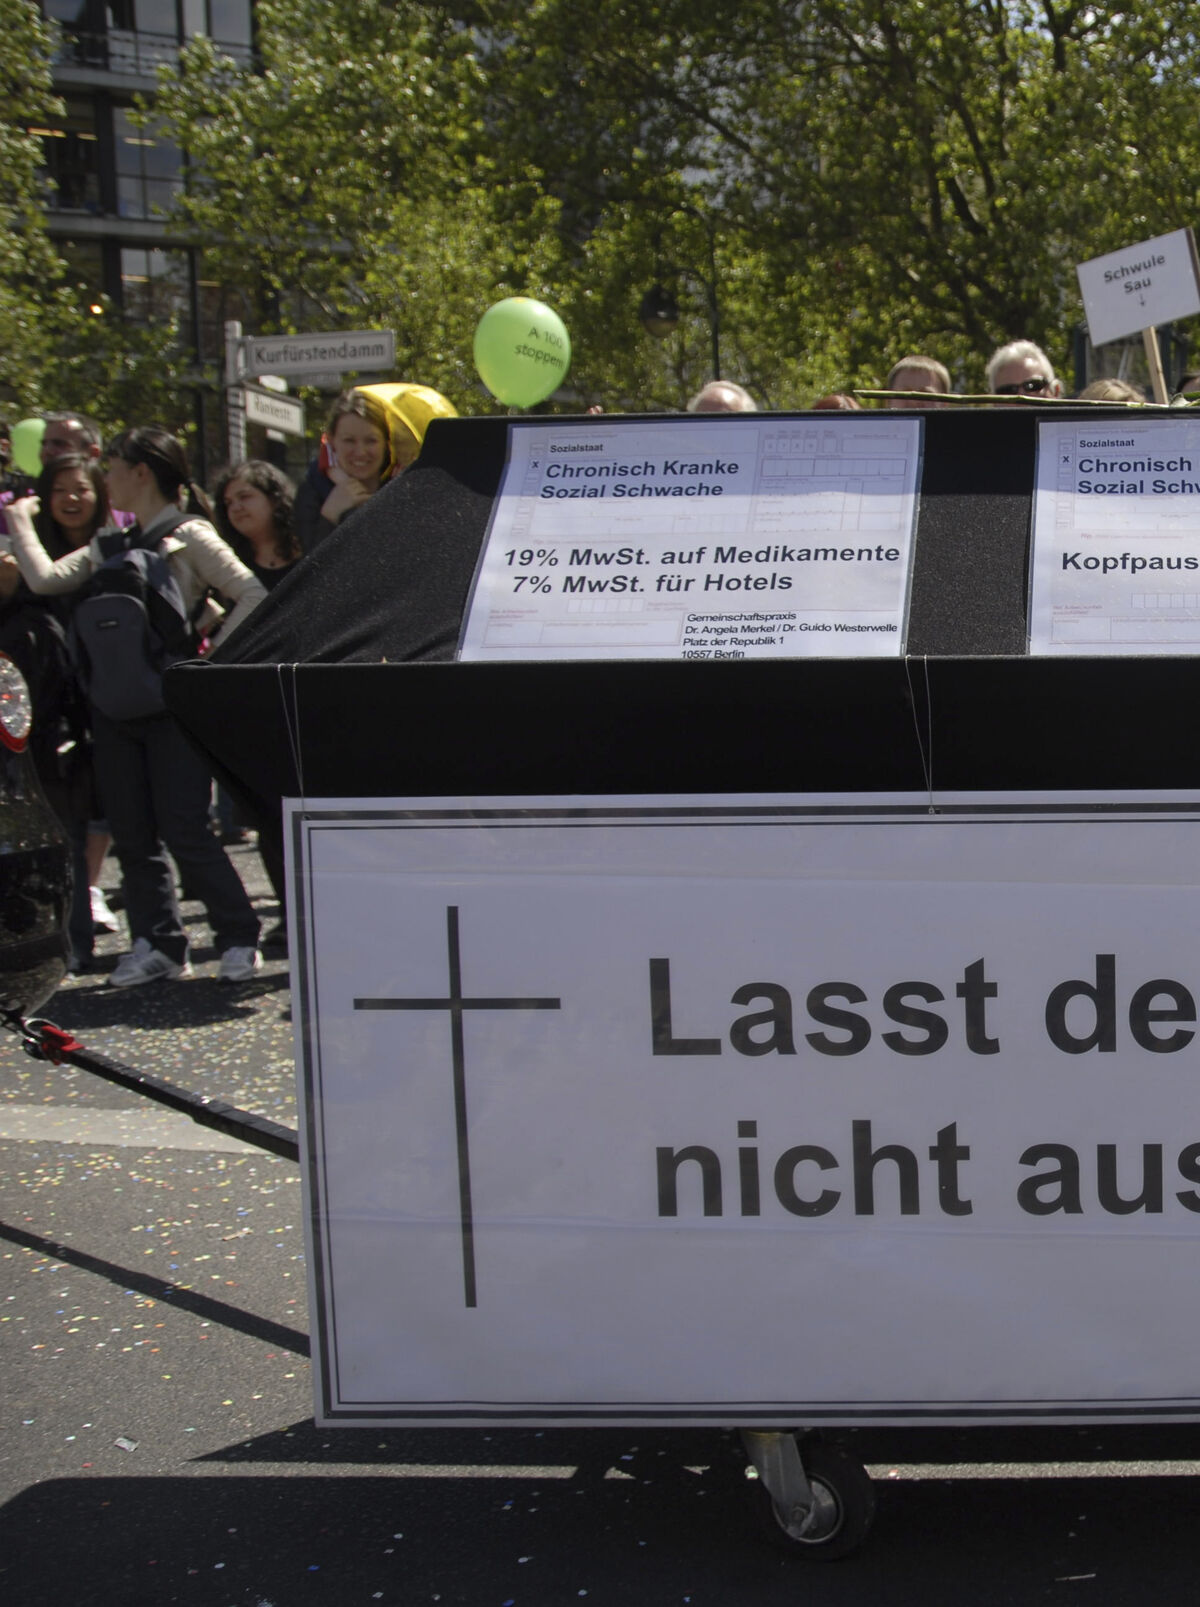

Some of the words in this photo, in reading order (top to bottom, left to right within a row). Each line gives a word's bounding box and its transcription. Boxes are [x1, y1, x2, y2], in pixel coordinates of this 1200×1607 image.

[1104, 254, 1166, 283] Schwule
[1124, 277, 1152, 294] Sau
[528, 326, 540, 339] A
[255, 341, 385, 364] Kurfürstendamm
[550, 443, 604, 453] Sozialstaat
[1080, 439, 1135, 448] Sozialstaat
[546, 461, 655, 479] Chronisch
[663, 459, 739, 475] Kranke
[1078, 457, 1192, 473] Chronisch
[540, 484, 606, 499] Sozial
[612, 482, 724, 498] Schwache
[1078, 480, 1145, 494] Sozial
[504, 549, 559, 567] 19%
[568, 547, 651, 566] MwSt.
[660, 546, 707, 565] auf
[713, 545, 901, 564] Medikamente
[512, 575, 552, 594] 7%
[562, 574, 645, 593] MwSt.
[655, 573, 696, 592] für
[703, 573, 793, 592] Hotels
[687, 611, 796, 622] Gemeinschaftspraxis
[685, 626, 699, 634] Dr.
[701, 625, 738, 636] Angela
[740, 624, 775, 633] Merkel
[782, 624, 796, 632] Dr.
[799, 623, 832, 632] Guido
[834, 624, 898, 633] Westerwelle
[682, 637, 708, 647] Platz
[710, 637, 727, 646] der
[729, 636, 776, 647] Republik
[681, 650, 711, 659] 10557
[714, 650, 745, 659] Berlin
[650, 958, 1000, 1056] Lasst
[656, 1120, 973, 1217] nicht
